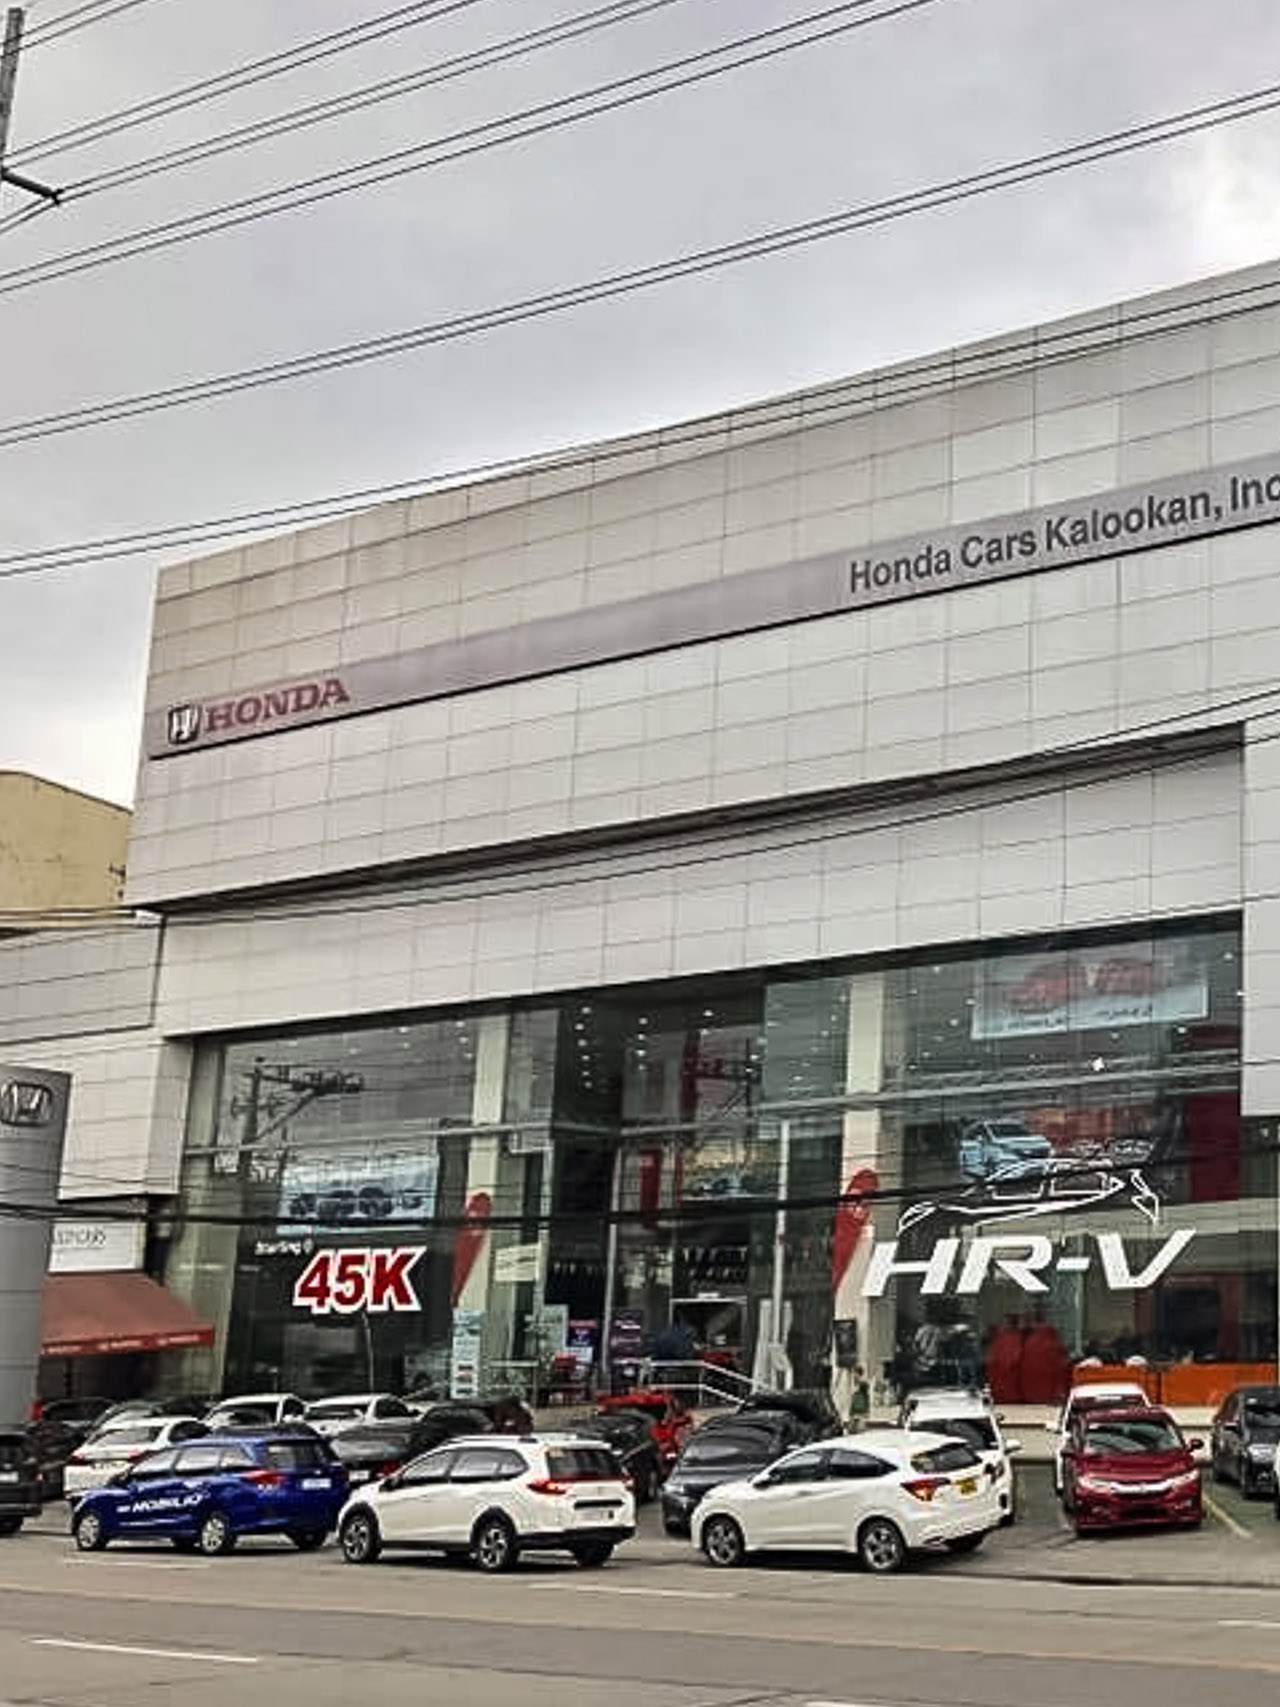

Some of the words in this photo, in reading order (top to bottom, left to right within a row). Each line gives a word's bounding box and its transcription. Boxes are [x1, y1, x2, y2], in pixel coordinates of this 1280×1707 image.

[850, 544, 952, 594] Honda
[960, 528, 1037, 568] Cars
[1045, 490, 1224, 553] Kalookan,
[203, 678, 350, 732] HONDA
[292, 1245, 428, 1315] 45K
[861, 1229, 1197, 1297] HR-V
